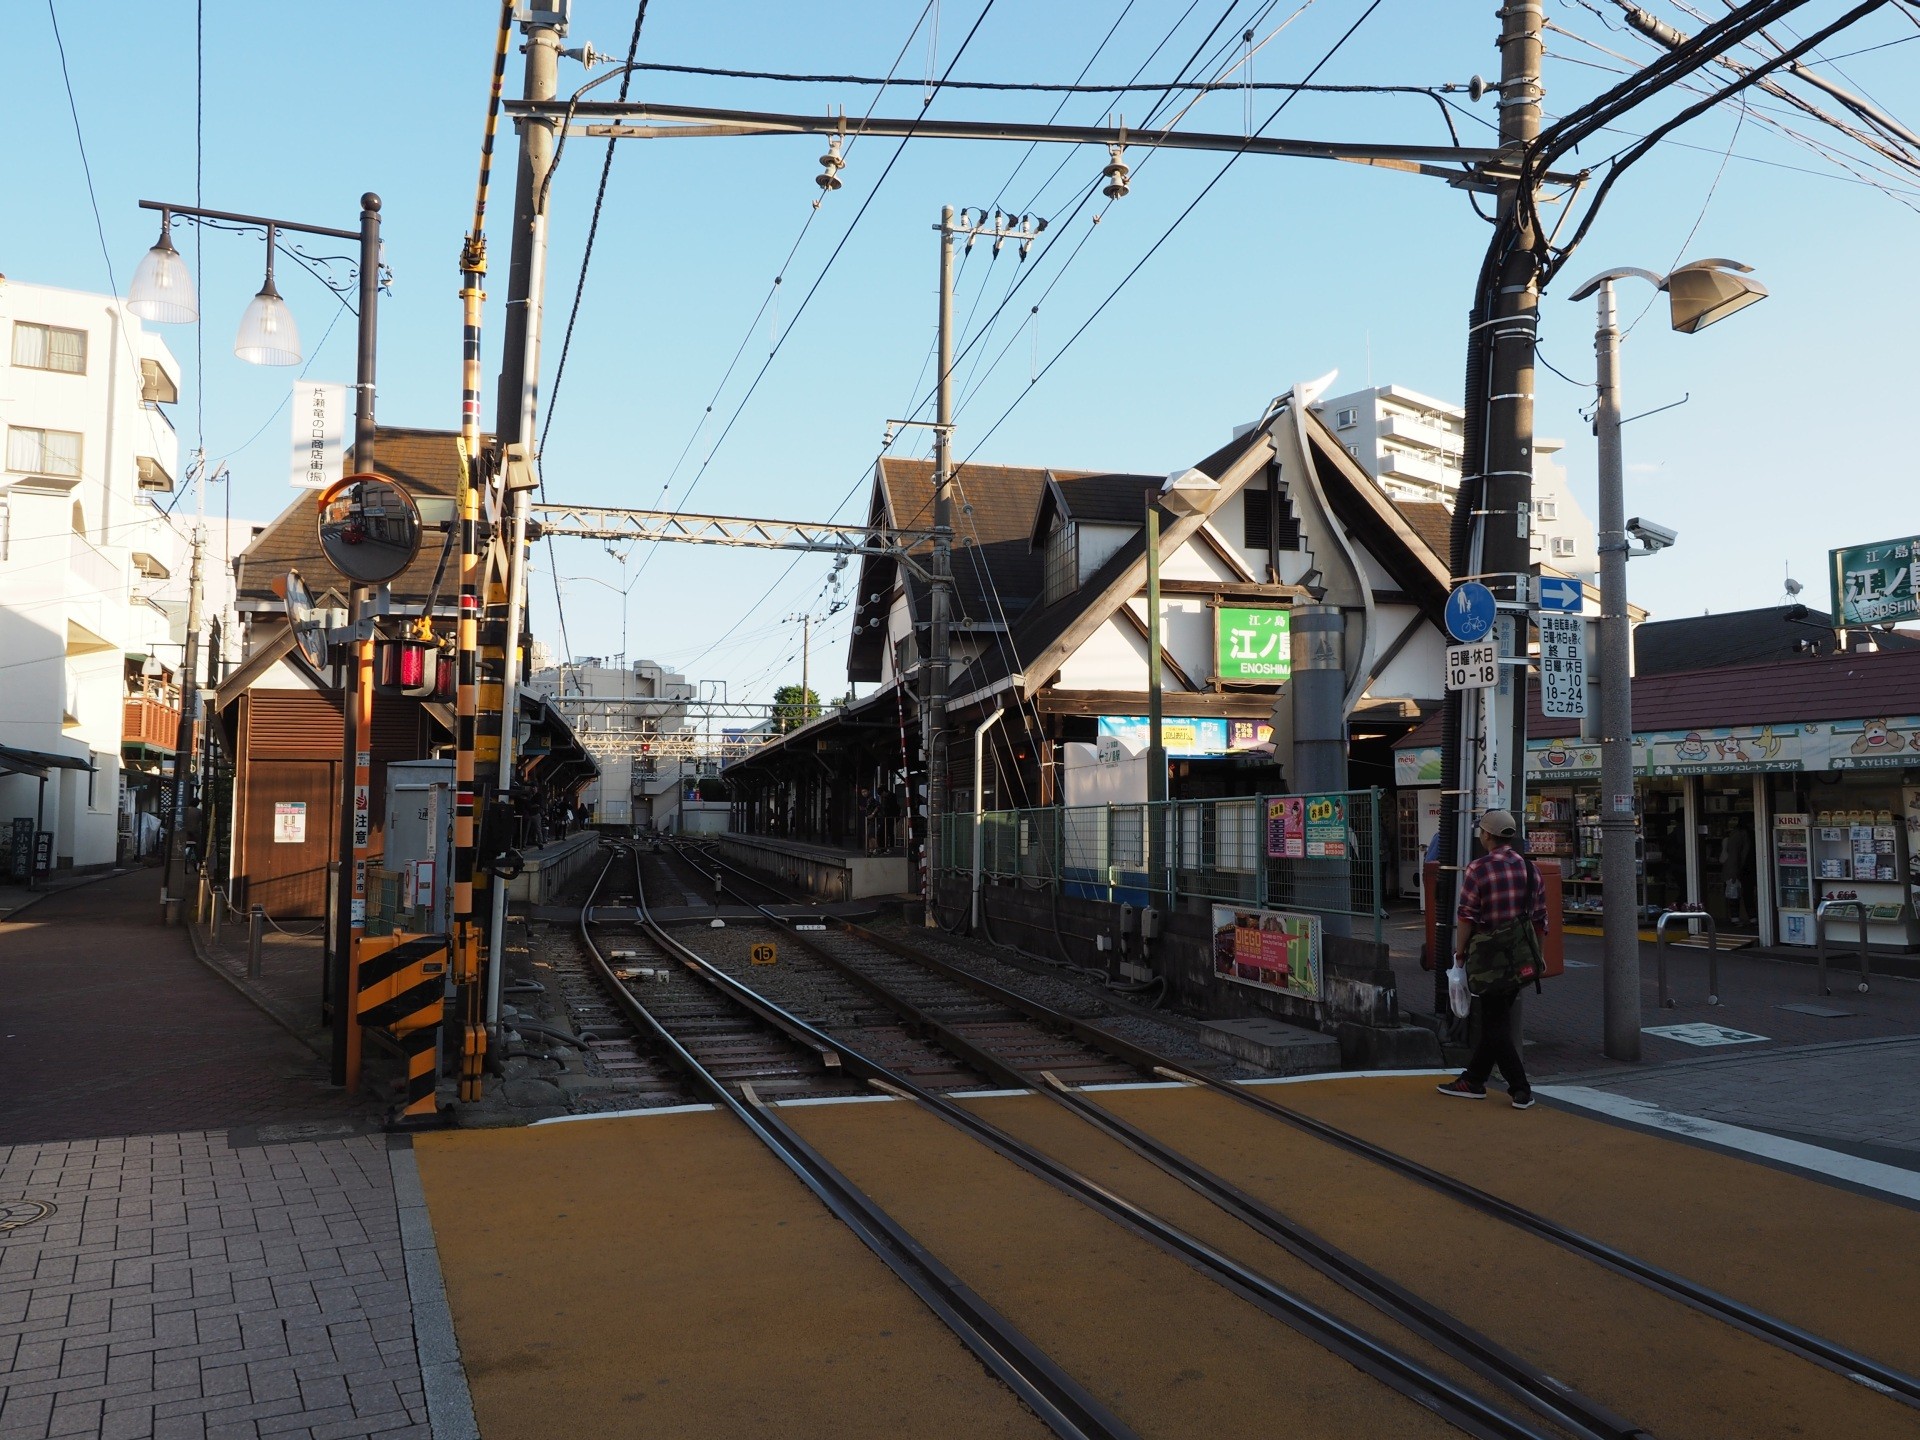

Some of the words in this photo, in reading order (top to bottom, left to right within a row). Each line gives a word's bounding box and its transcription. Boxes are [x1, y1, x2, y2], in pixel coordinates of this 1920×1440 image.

[1249, 614, 1286, 628] 江ノ島
[1547, 700, 1583, 713] ここから
[1397, 754, 1416, 764] meiji
[1765, 761, 1799, 770] アーモンド
[1778, 816, 1803, 825] KIRIN
[355, 814, 367, 845] 注意
[1236, 929, 1262, 948] DIEGO
[757, 947, 770, 960] 15
